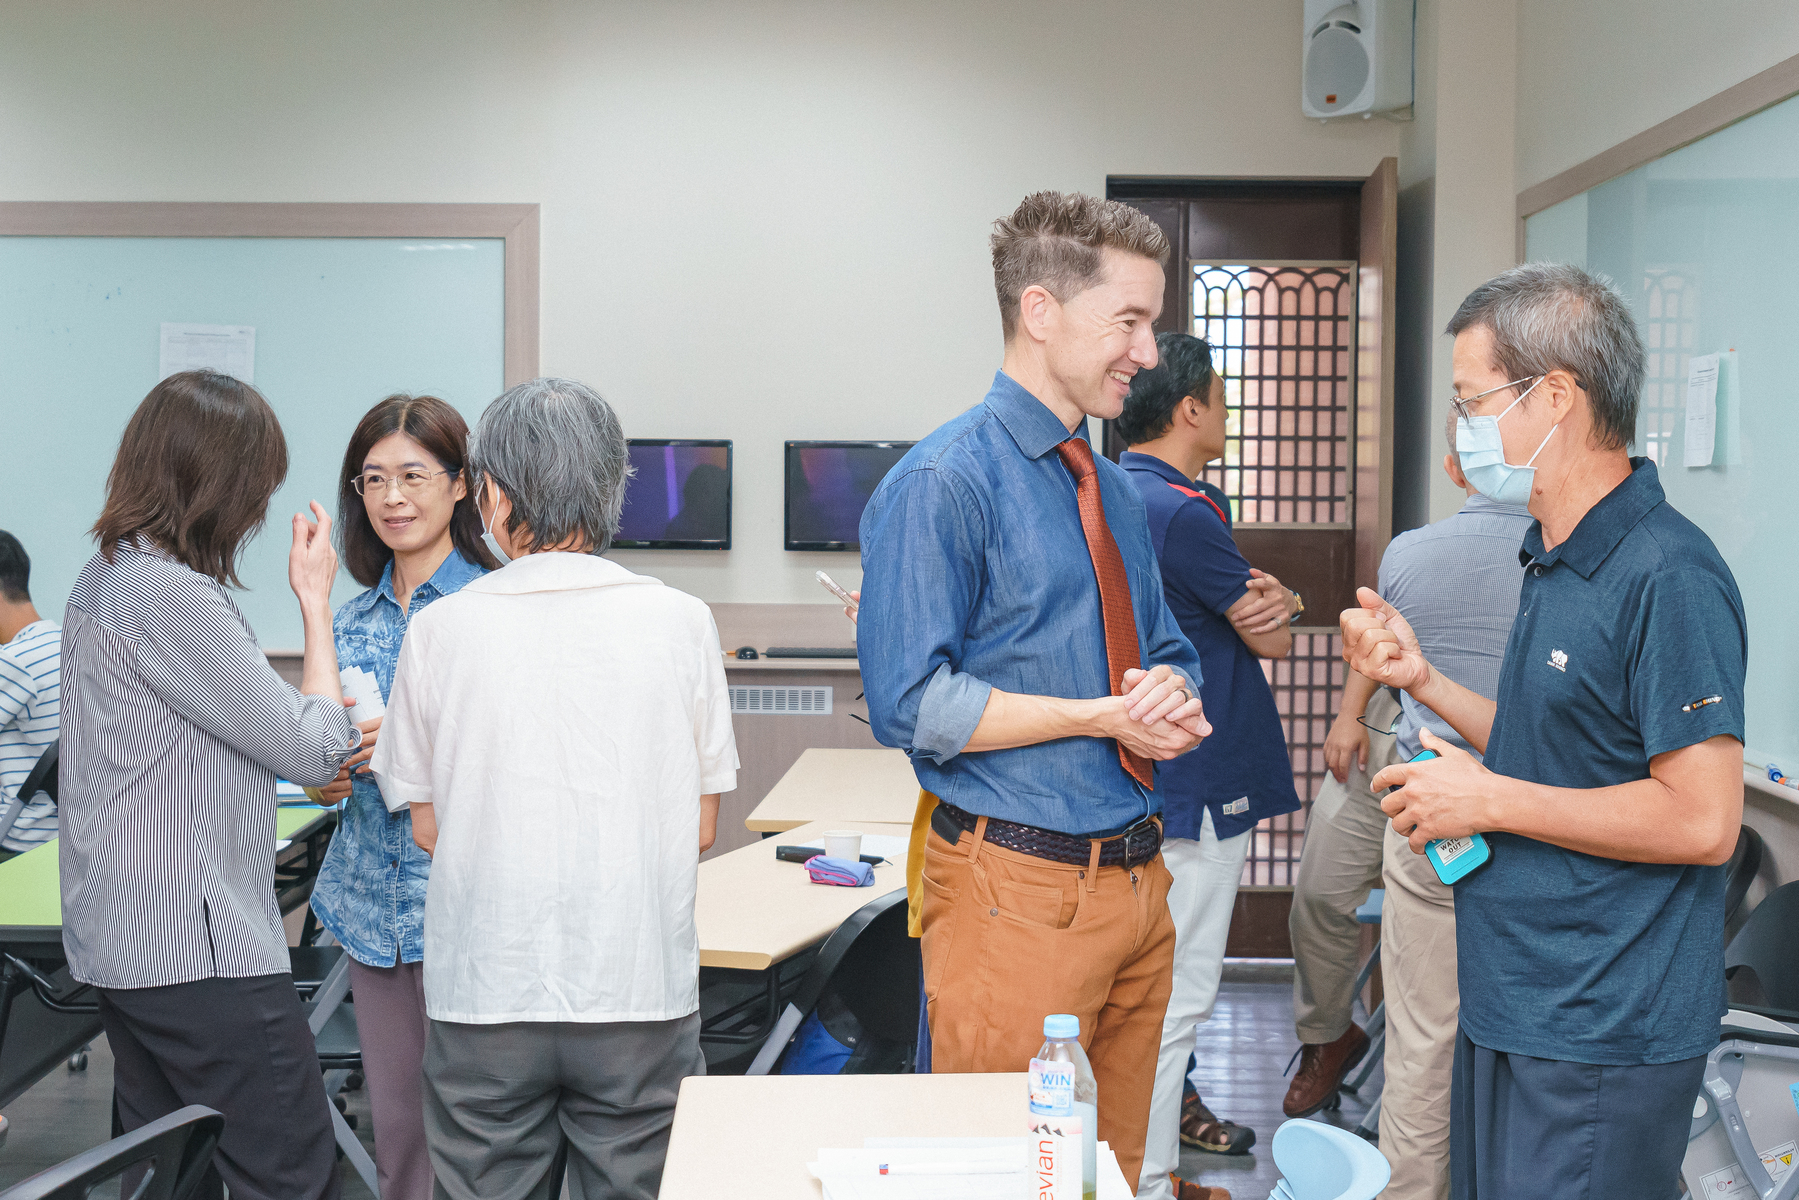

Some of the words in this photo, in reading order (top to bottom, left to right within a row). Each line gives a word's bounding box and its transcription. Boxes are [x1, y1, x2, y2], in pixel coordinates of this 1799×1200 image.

[1440, 837, 1461, 851] WATC
[1448, 841, 1462, 853] OUT
[1041, 1072, 1071, 1086] WIN
